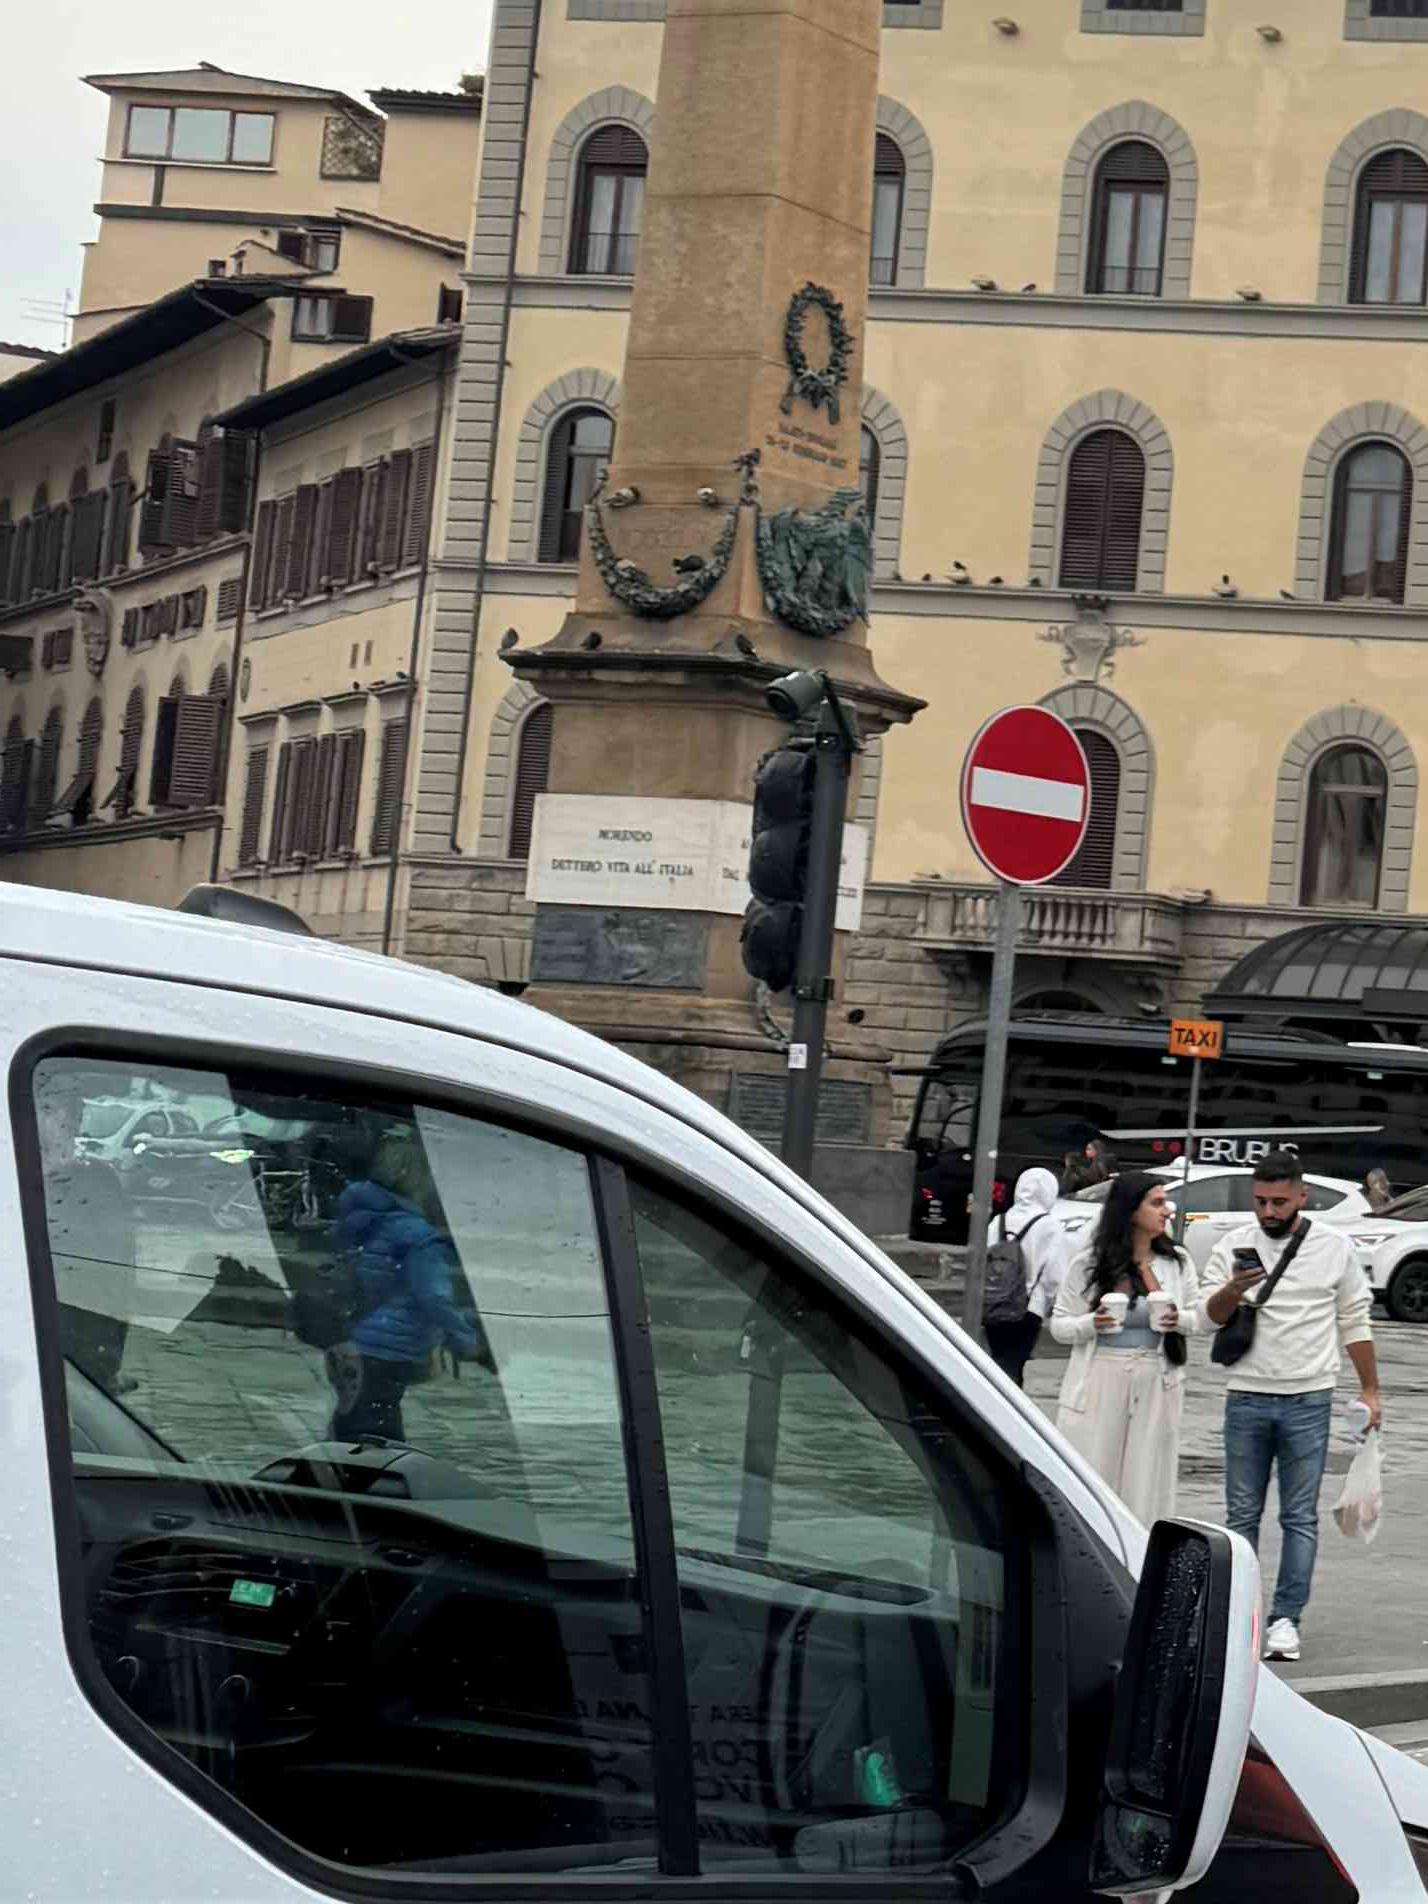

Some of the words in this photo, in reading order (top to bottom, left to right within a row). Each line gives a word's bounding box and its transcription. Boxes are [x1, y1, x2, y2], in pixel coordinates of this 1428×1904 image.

[608, 861, 629, 874] VITA
[660, 863, 693, 877] ITALIA
[1174, 1027, 1219, 1048] TAXI
